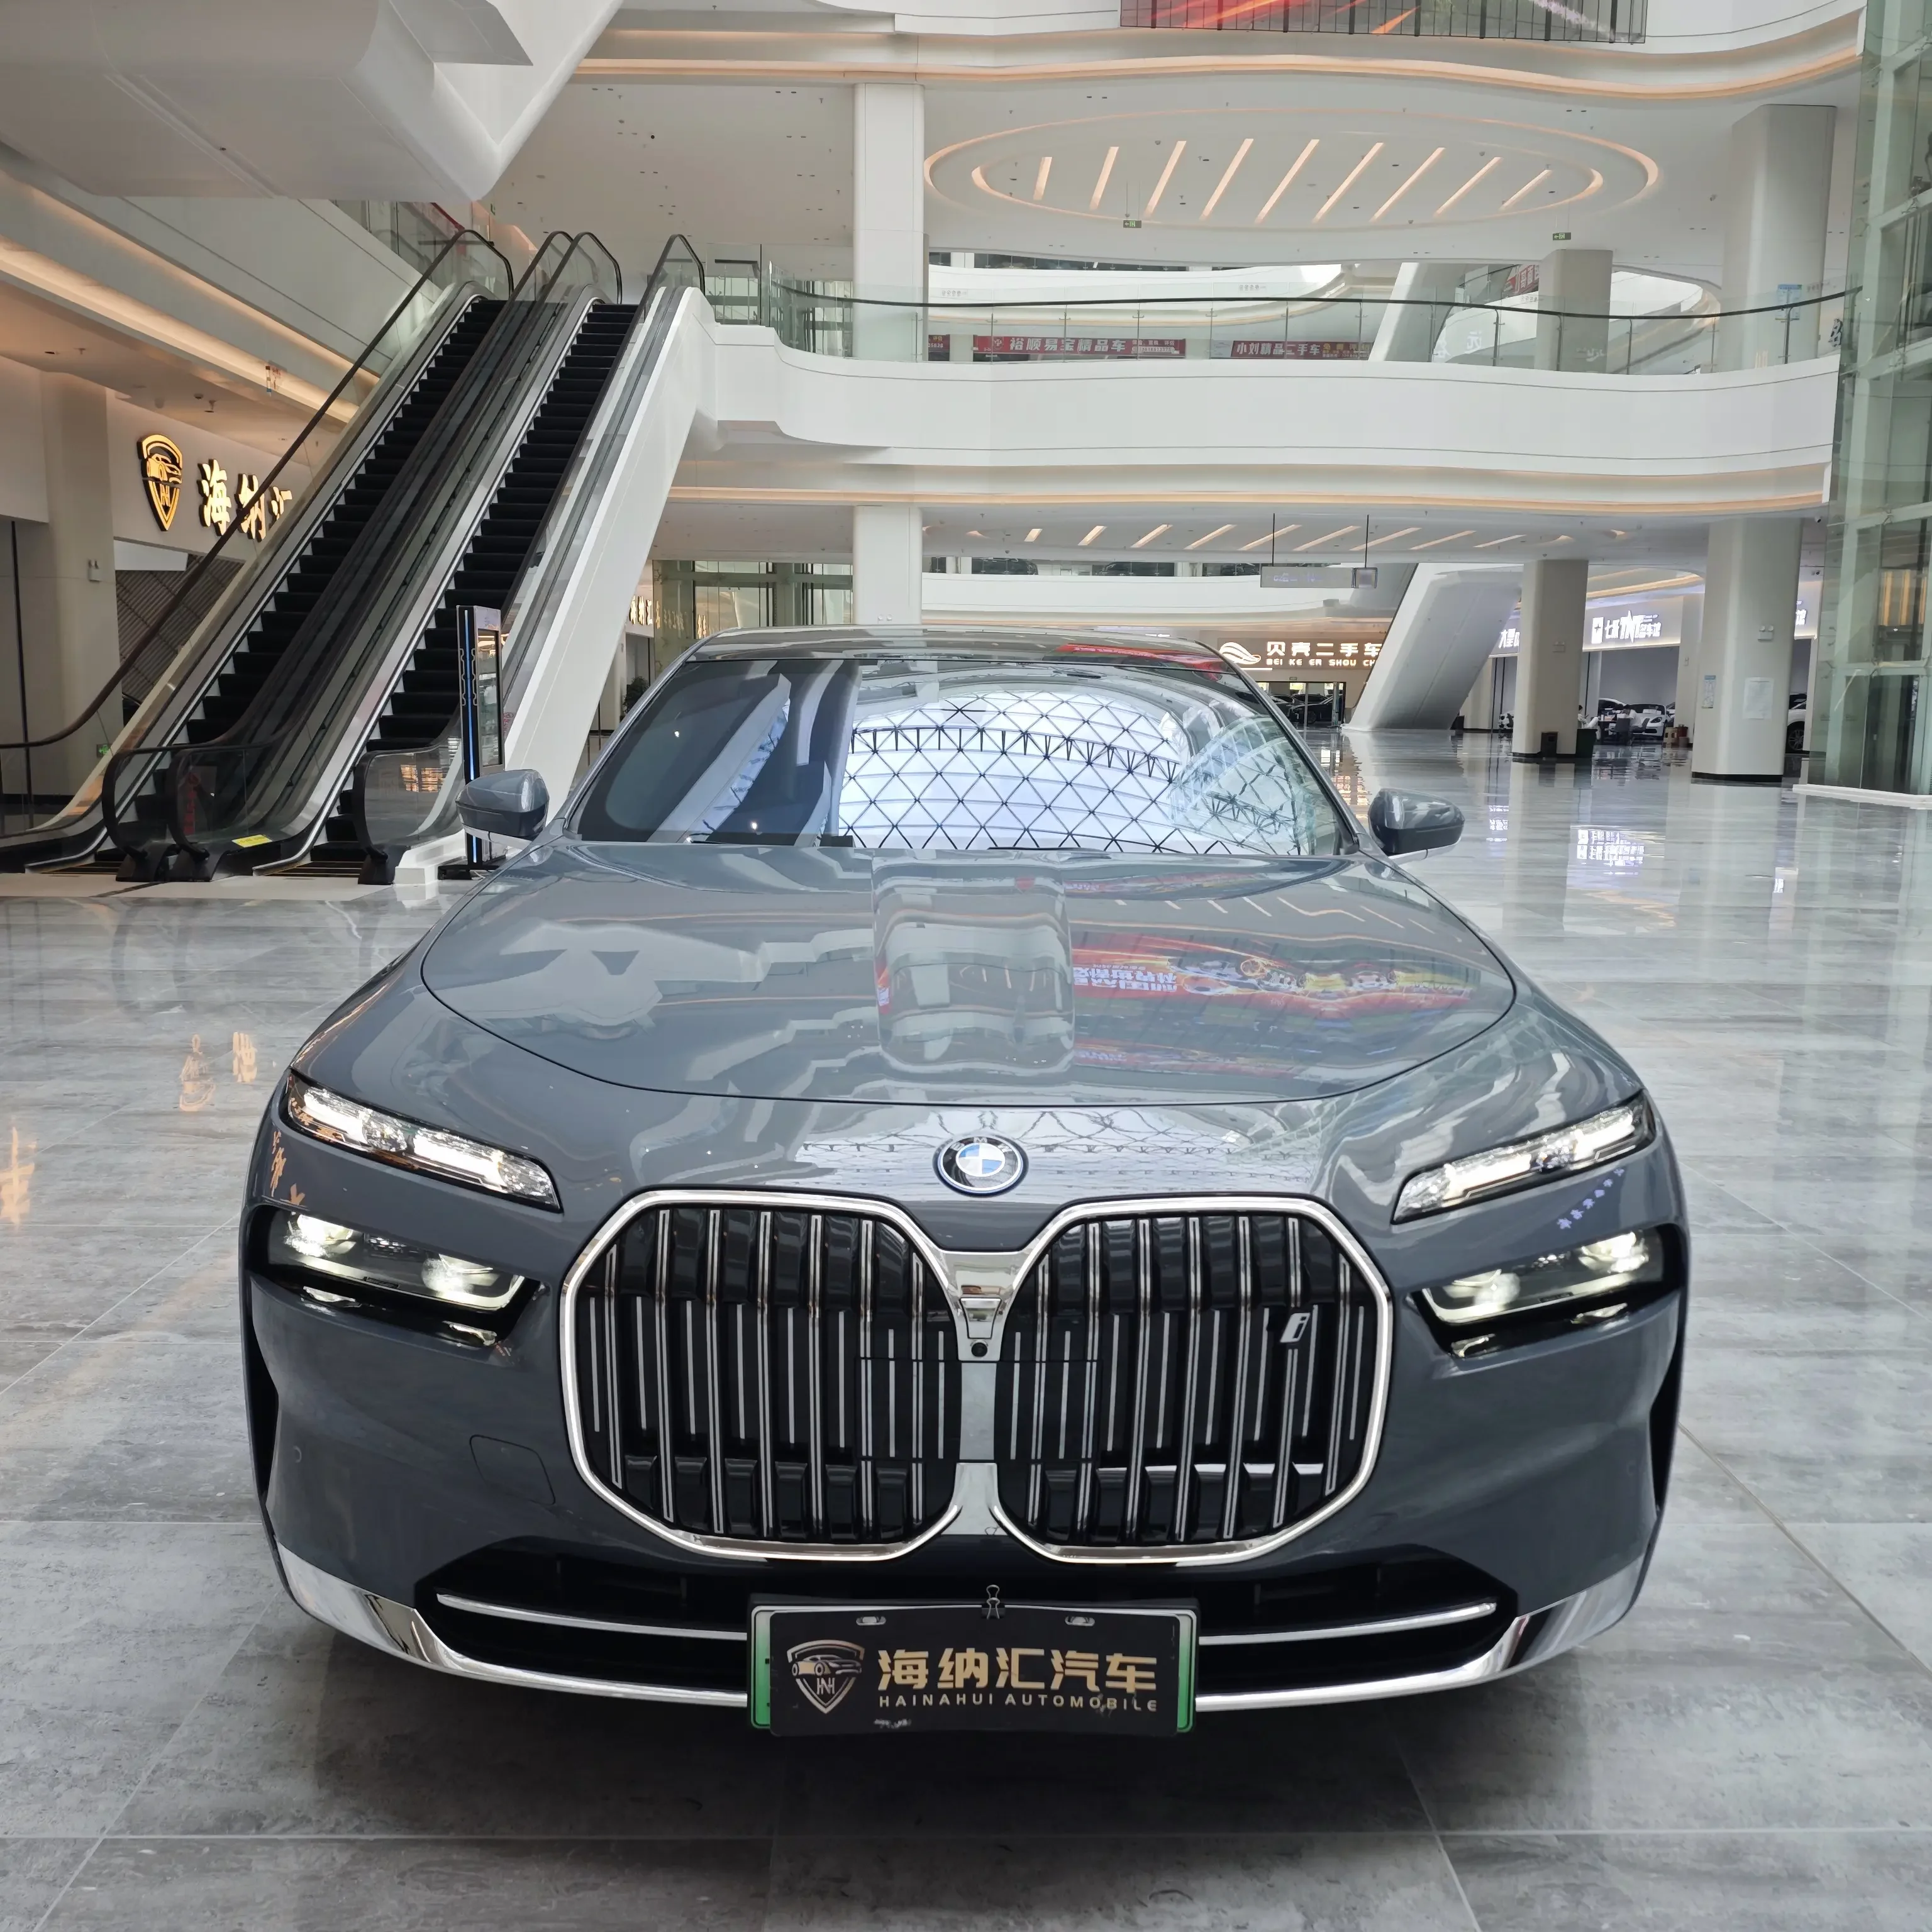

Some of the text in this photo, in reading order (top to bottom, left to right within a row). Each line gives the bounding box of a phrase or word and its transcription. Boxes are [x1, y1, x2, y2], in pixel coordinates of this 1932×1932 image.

[1267, 641, 1382, 657] 贝壳二手车
[878, 1648, 1157, 1693] 海纳汇汽车
[879, 1693, 1157, 1712] HAINAHUI AUTOMOBILE
